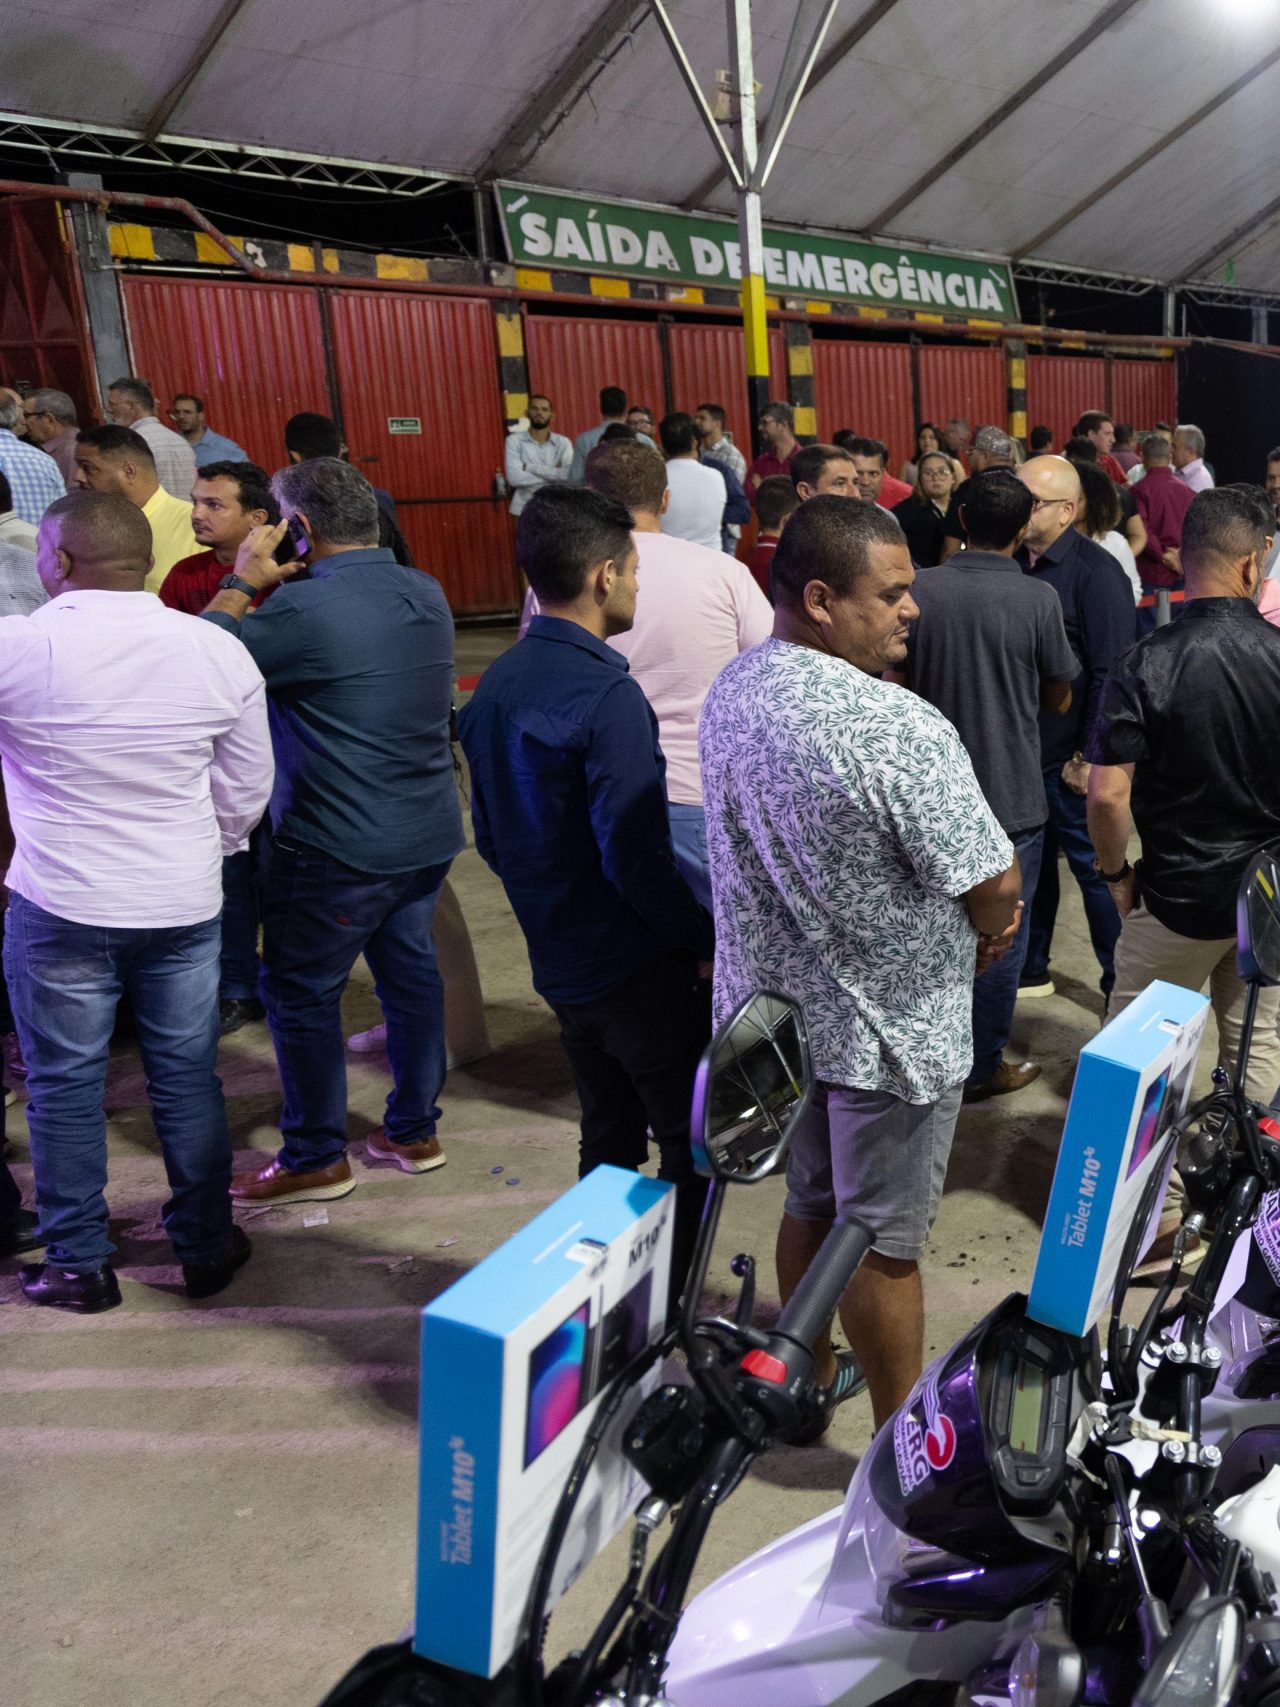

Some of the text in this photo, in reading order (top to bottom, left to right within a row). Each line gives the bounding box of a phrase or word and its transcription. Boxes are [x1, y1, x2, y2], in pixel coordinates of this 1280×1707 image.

[519, 208, 1004, 312] SAÍDA DE EMERGÊNCIA
[1067, 1199, 1092, 1248] Tablet
[1255, 1228, 1264, 1245] RIO
[450, 1503, 473, 1565] Tablet
